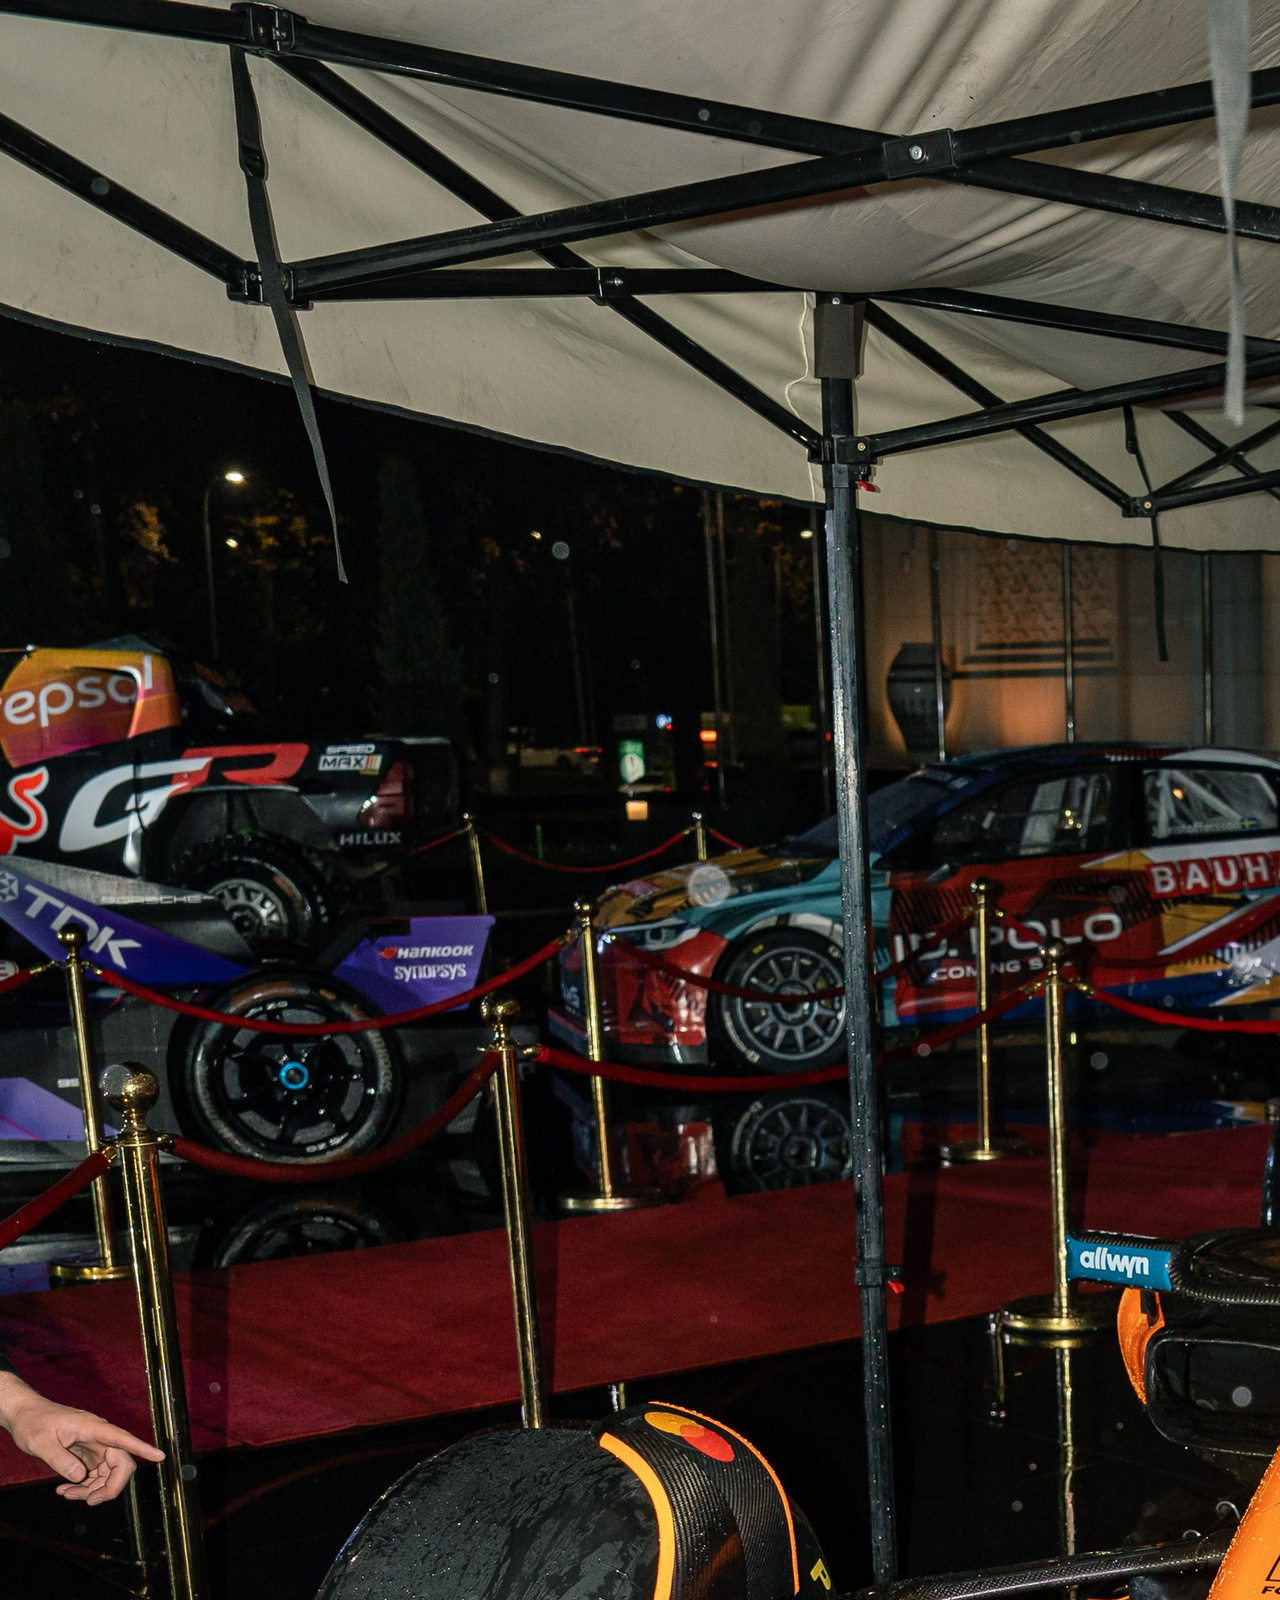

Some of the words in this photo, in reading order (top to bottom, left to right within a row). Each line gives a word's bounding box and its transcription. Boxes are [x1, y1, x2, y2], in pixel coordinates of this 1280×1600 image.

[0, 654, 153, 728] epsol
[339, 831, 402, 846] HILUX
[24, 883, 142, 970] TDK
[1079, 1246, 1150, 1279] allwyn
